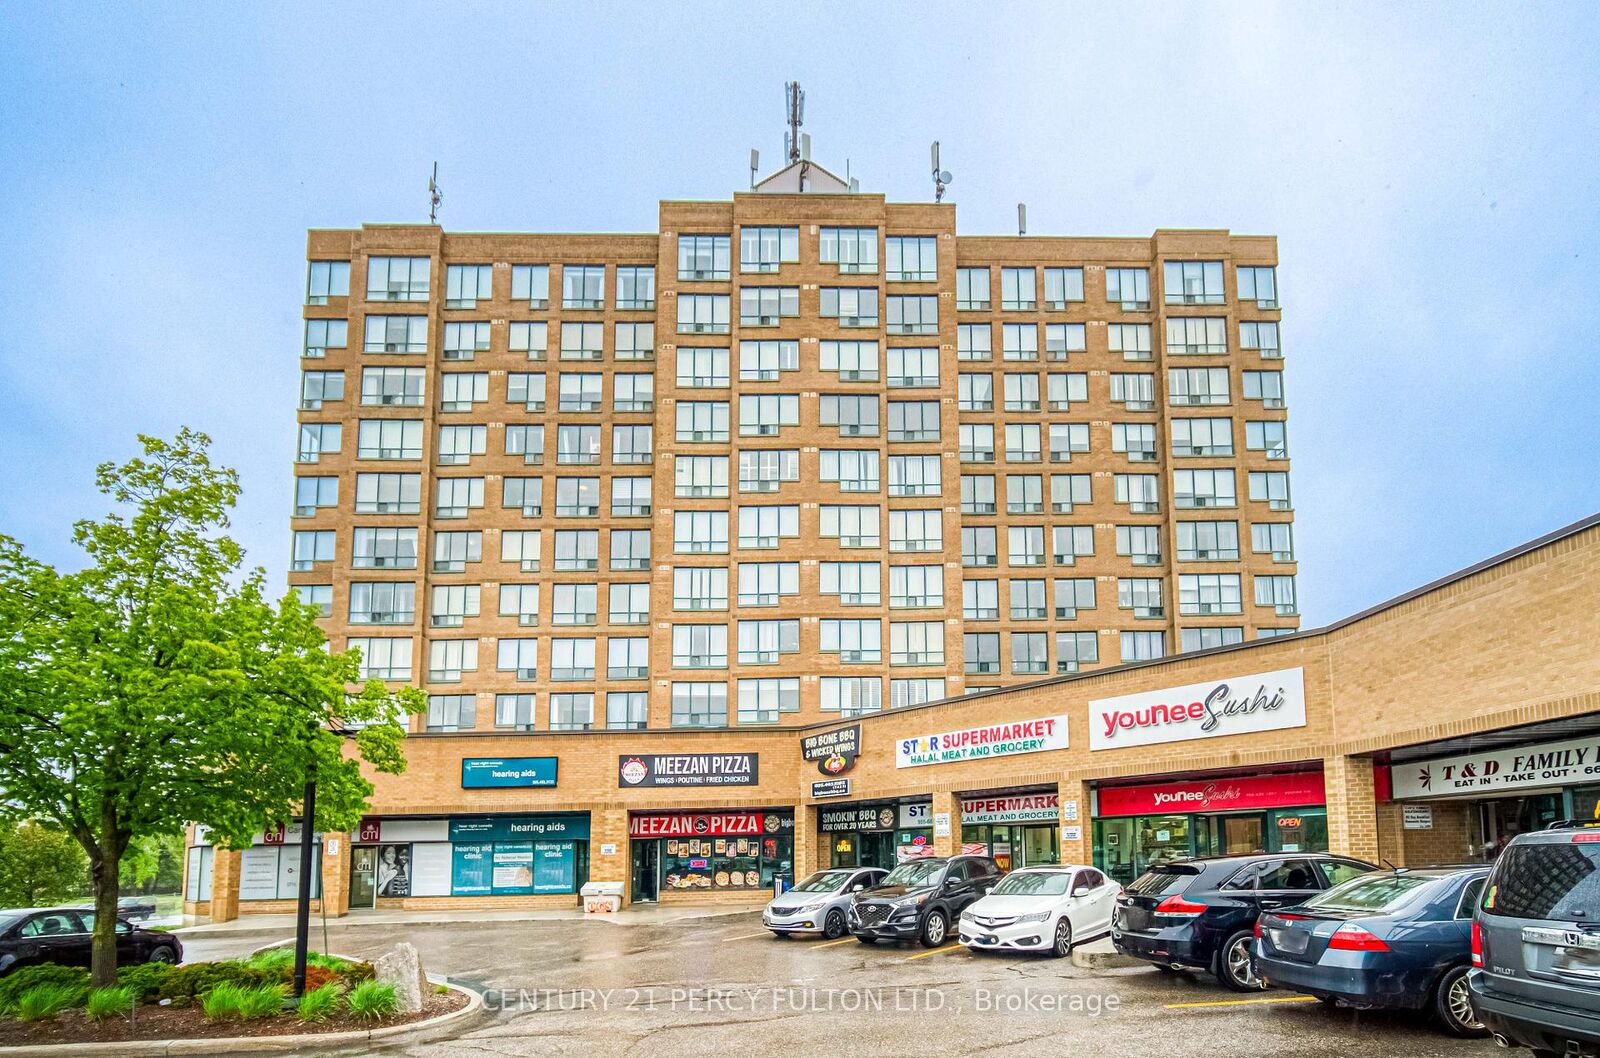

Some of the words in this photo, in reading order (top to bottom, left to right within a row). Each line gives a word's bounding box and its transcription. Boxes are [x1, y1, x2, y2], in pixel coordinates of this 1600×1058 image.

[1201, 684, 1285, 731] Sushi
[805, 737, 817, 748] BIG
[818, 733, 838, 746] BONE
[839, 730, 855, 742] BBQ
[943, 719, 1055, 749] SUPERMARKET
[811, 746, 834, 757] WICKED
[834, 742, 855, 753] WINGS
[910, 754, 939, 764] HALAL
[941, 749, 967, 760] MEAT
[969, 745, 990, 757] AND
[993, 738, 1045, 754] GROCERY
[654, 757, 708, 774] MEEZAN
[712, 756, 751, 773] PIZZA
[1442, 765, 1456, 781] T
[1461, 763, 1477, 778] &
[1483, 760, 1500, 776] D
[1512, 746, 1590, 772] FAMILY
[492, 770, 520, 778] hearing
[1455, 779, 1475, 788] EAT
[1480, 778, 1490, 786] IN
[1504, 772, 1535, 782] TAKE
[1542, 768, 1569, 778] OUT
[822, 811, 858, 823] SMOKIN'
[859, 810, 876, 820] BBQ
[1018, 810, 1058, 820] GROCERY
[511, 822, 544, 833] hearing
[546, 823, 566, 832] aids
[711, 816, 758, 833] PIZZA
[822, 822, 833, 830] FOR
[834, 822, 848, 830] OVER
[858, 821, 876, 829] YEARS
[1278, 818, 1302, 827] OPEN
[455, 845, 480, 853] hearing
[836, 844, 851, 852] OPEN
[1493, 966, 1516, 976] PILOT
